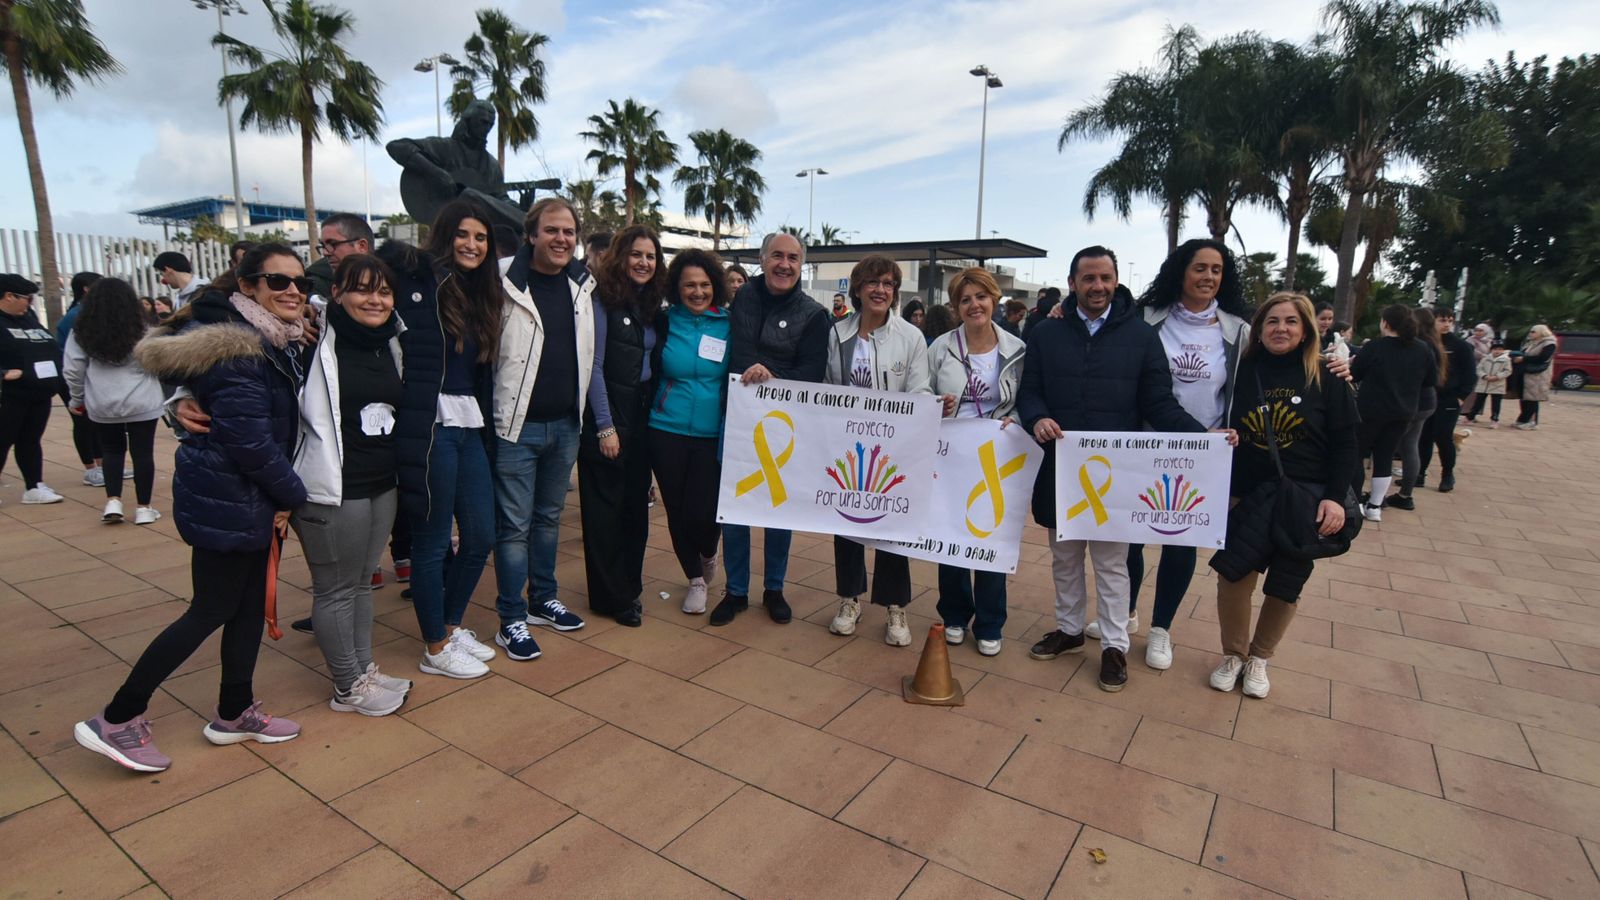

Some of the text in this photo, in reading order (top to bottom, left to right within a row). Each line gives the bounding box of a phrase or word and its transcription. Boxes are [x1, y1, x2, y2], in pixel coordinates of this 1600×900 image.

[797, 390, 808, 404] al
[864, 396, 914, 415] infantil
[1112, 438, 1122, 449] al
[1167, 439, 1210, 451] infantil
[839, 491, 862, 509] una
[863, 494, 910, 514] sonrisa
[1150, 512, 1170, 524] una
[1171, 512, 1210, 526] sonrisa
